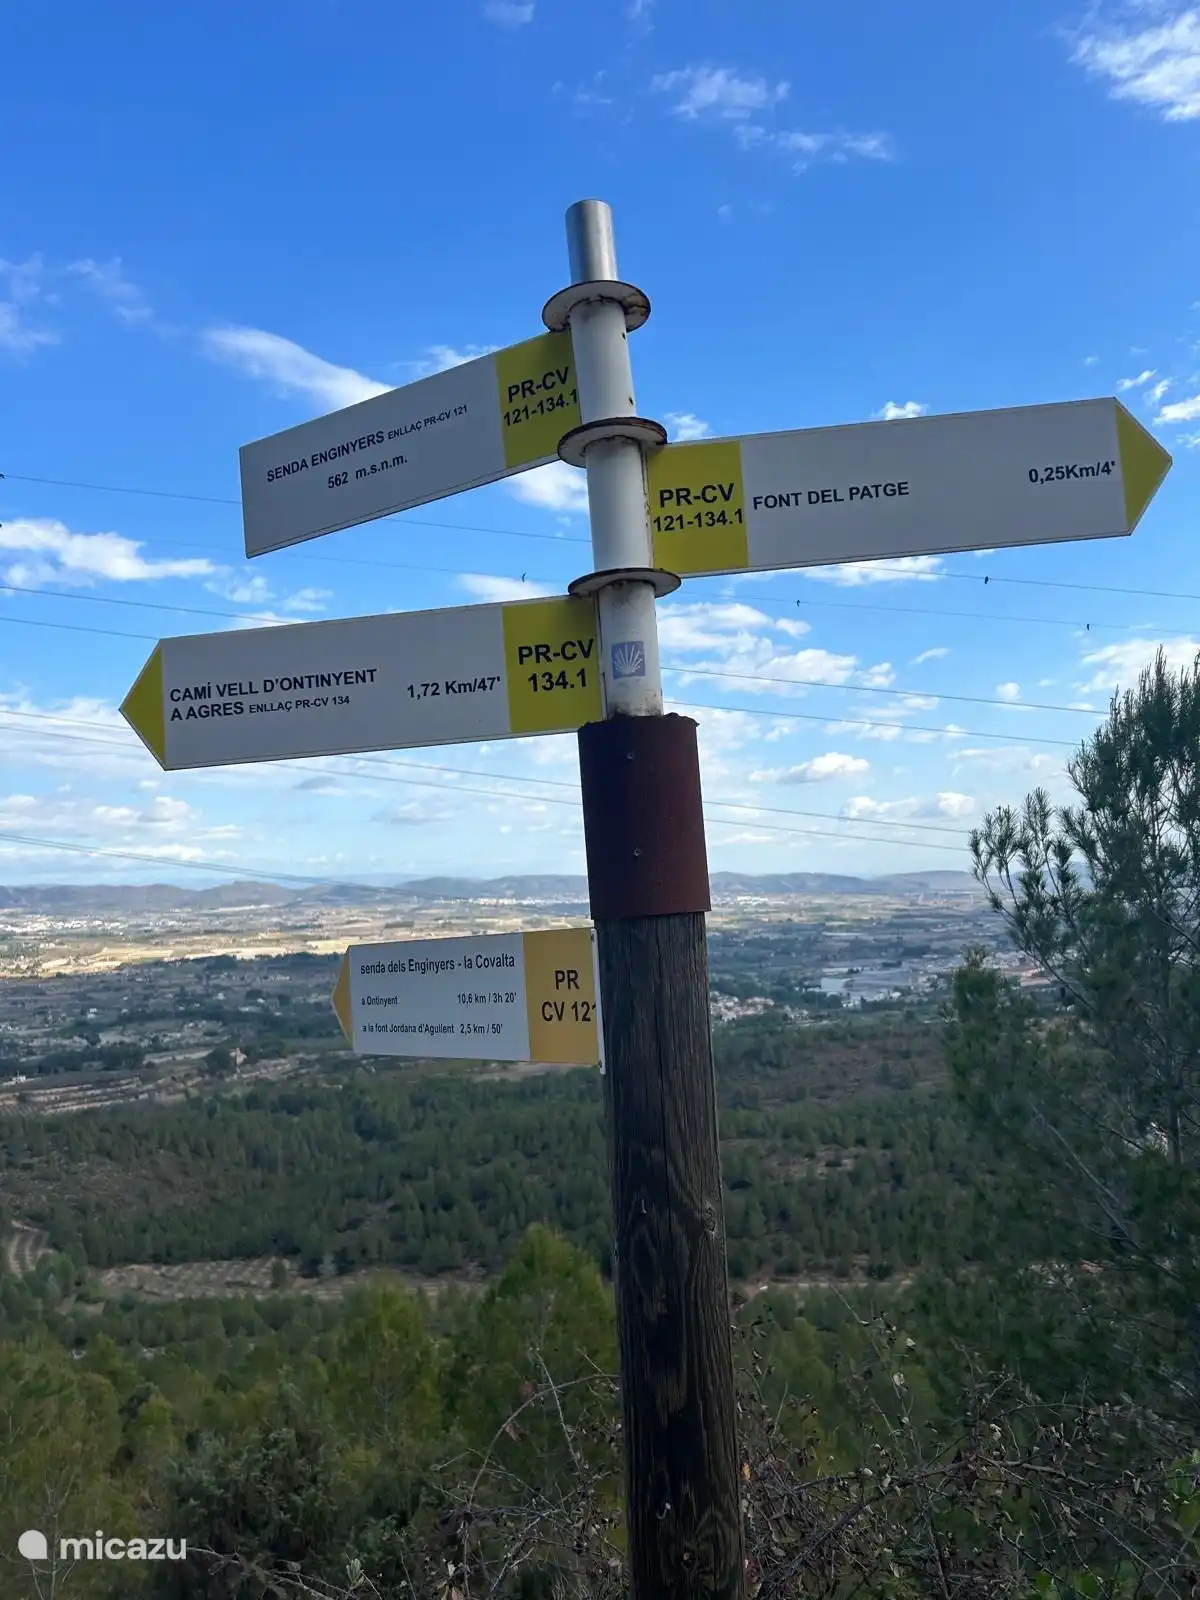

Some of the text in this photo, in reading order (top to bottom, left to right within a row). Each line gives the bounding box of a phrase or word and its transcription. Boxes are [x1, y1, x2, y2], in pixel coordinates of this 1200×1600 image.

[507, 367, 570, 403] PR-CV
[503, 389, 578, 427] 121-134.1
[266, 405, 468, 483] SENDA ENGINYERS ENLLAÇ PR-CV 121
[327, 456, 408, 489] 562 m.s.n.m.
[1028, 460, 1116, 485] 0,25Km/4'
[659, 483, 735, 508] PR-CV
[753, 482, 910, 511] FONT DEL PATGE
[654, 508, 744, 533] 121-134.1
[518, 639, 594, 665] PR-CV
[170, 680, 213, 703] CAMÍ
[215, 680, 259, 699] VELL
[407, 675, 501, 700] 1,72 Km/47'
[528, 668, 587, 693] 134.1
[171, 695, 350, 721] A AGRES ENLLAÇ PR-CV 134
[360, 962, 385, 976] senda
[388, 958, 406, 974] dels
[408, 956, 455, 976] Enginyers
[464, 955, 473, 970] la
[475, 953, 516, 970] Covalta
[554, 969, 580, 990] PR
[366, 993, 398, 1006] Ontinyent
[457, 992, 473, 1006] 10,6
[474, 992, 487, 1003] km
[493, 991, 503, 1003] 3h
[541, 1000, 565, 1022] CV
[368, 1022, 374, 1033] la
[375, 1021, 388, 1033] font
[390, 1022, 416, 1033] Jordana
[460, 1022, 472, 1037] 2,5
[473, 1022, 485, 1034] km
